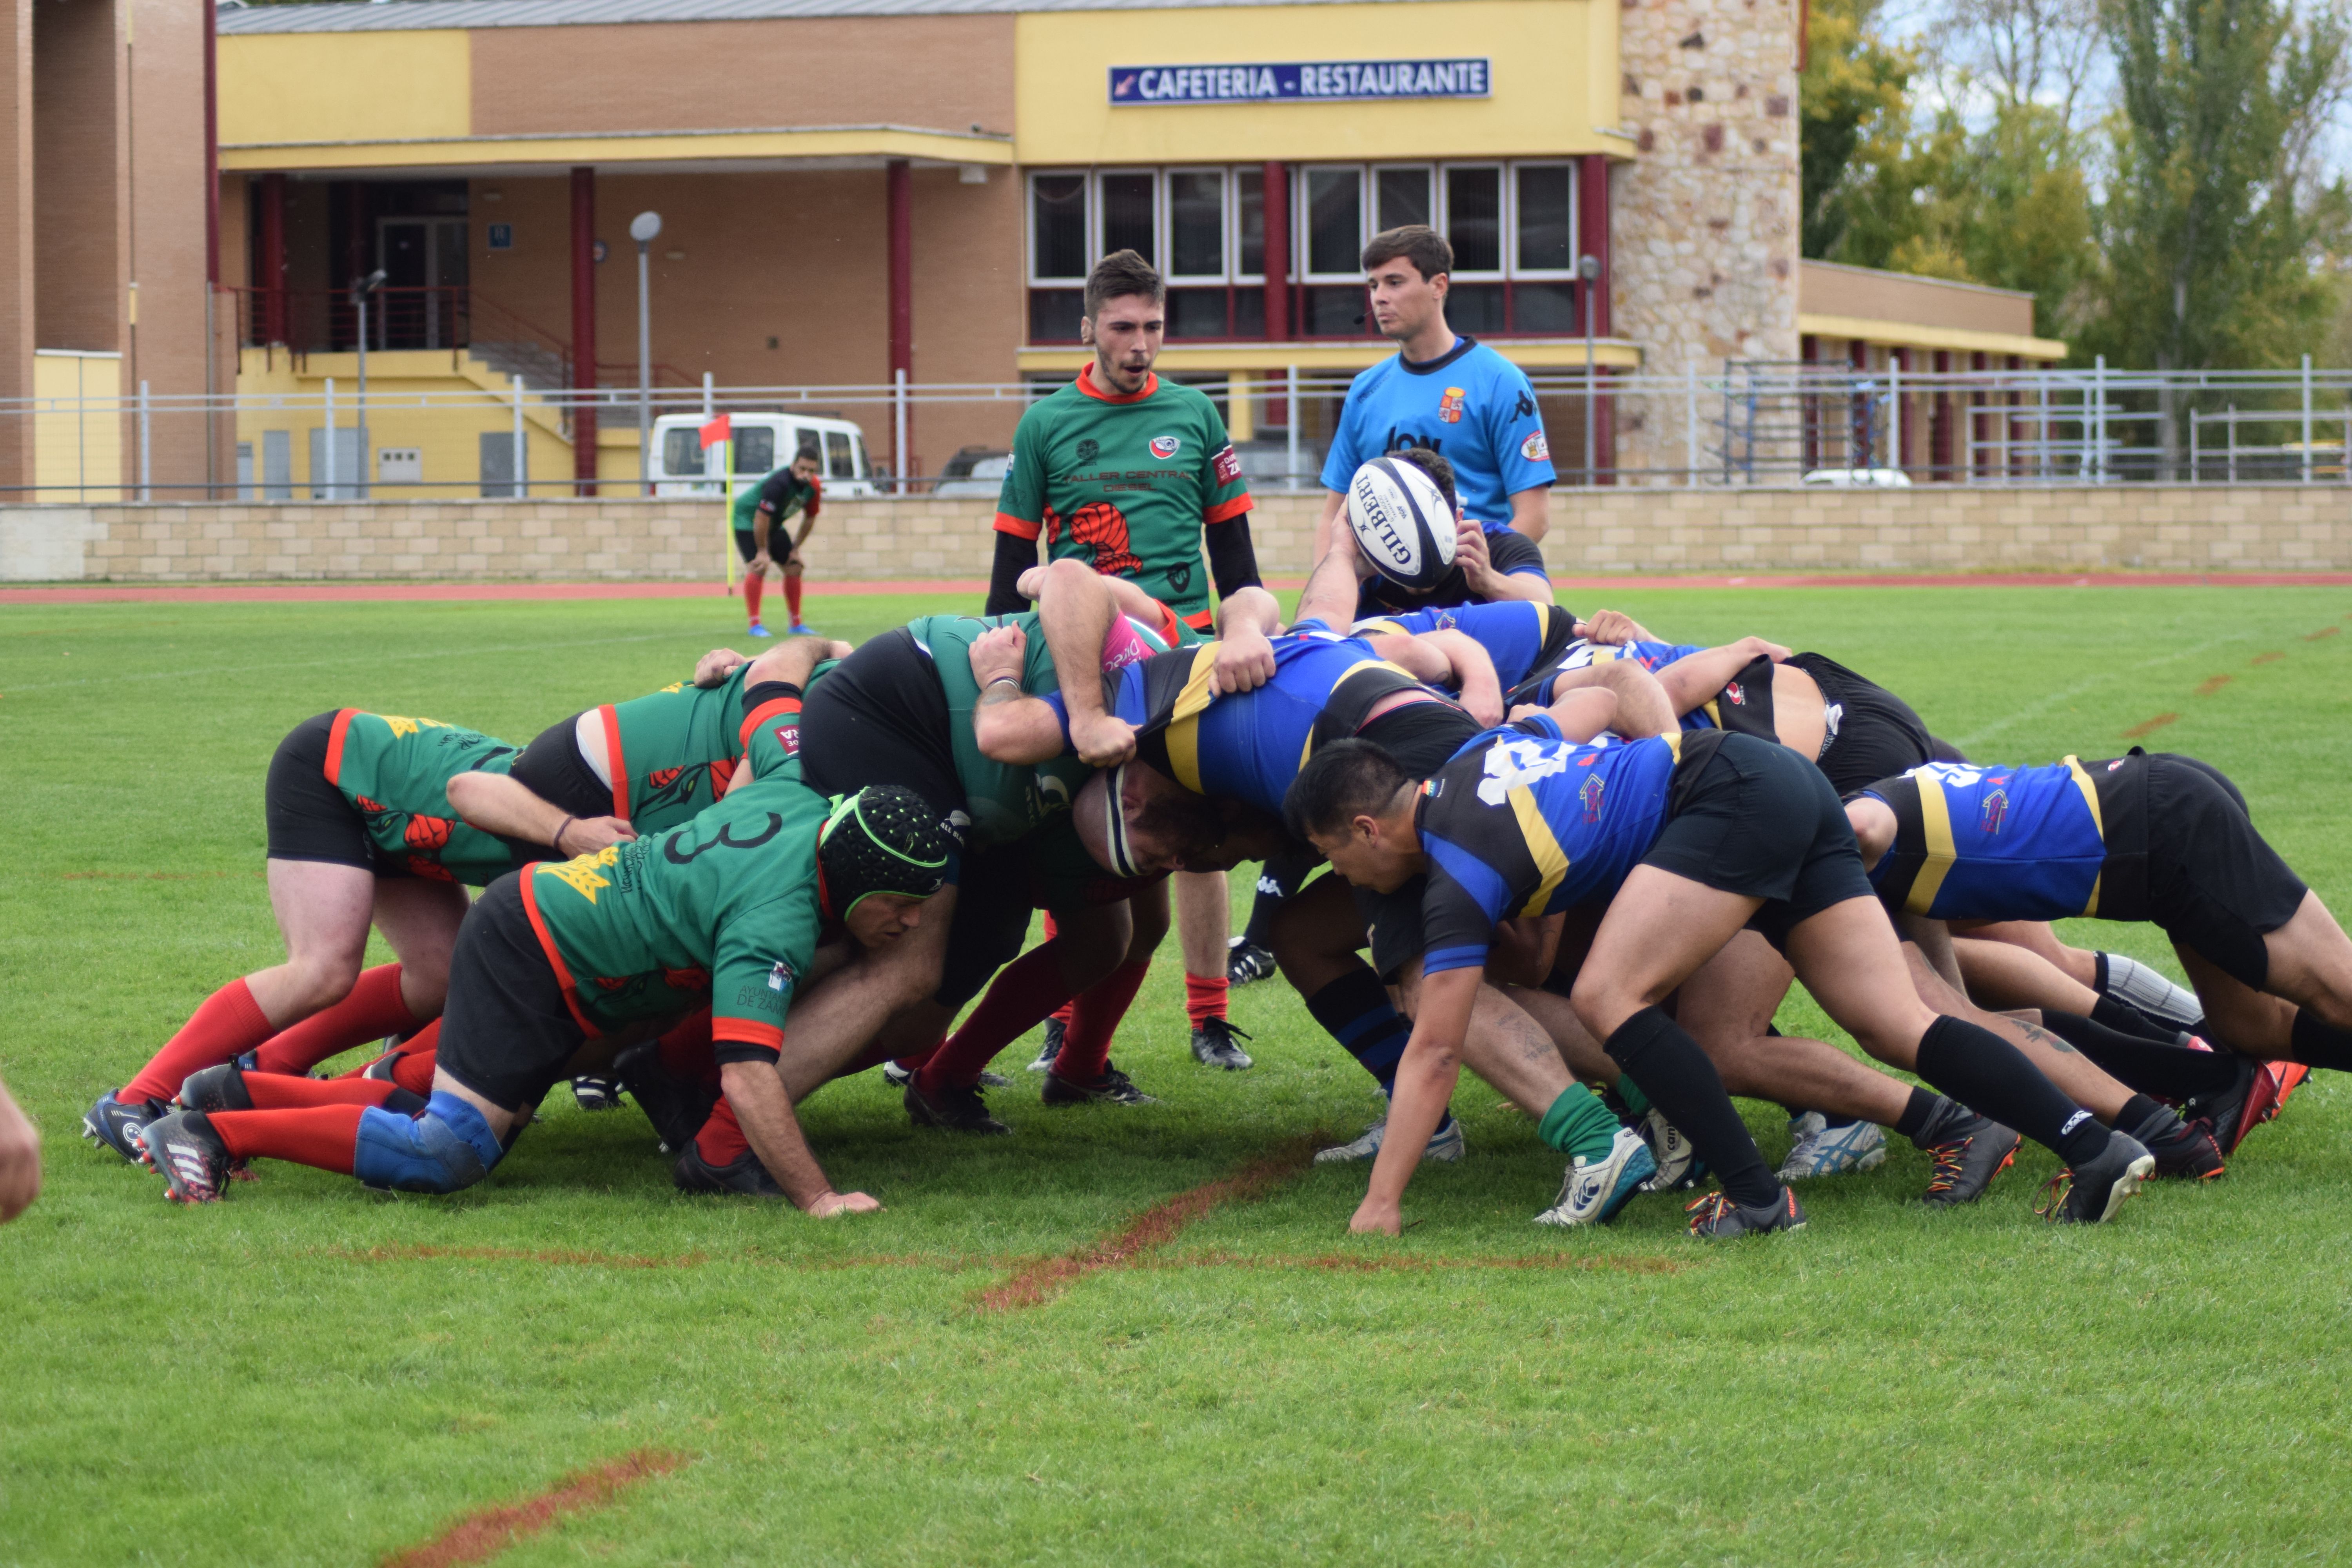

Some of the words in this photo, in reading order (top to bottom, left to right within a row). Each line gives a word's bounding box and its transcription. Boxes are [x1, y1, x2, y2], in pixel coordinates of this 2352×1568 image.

[1139, 69, 1277, 100] CAFETERIA
[1300, 62, 1486, 96] RESTAURANTE
[1063, 472, 1120, 483] TALLER
[1125, 470, 1192, 481] CENTRAL
[1103, 483, 1157, 492] DIESEL
[1355, 474, 1411, 565] GILBERT
[1102, 638, 1140, 673] Direc
[664, 811, 782, 864] 3
[940, 822, 951, 833] ALL
[737, 994, 755, 1007] DE
